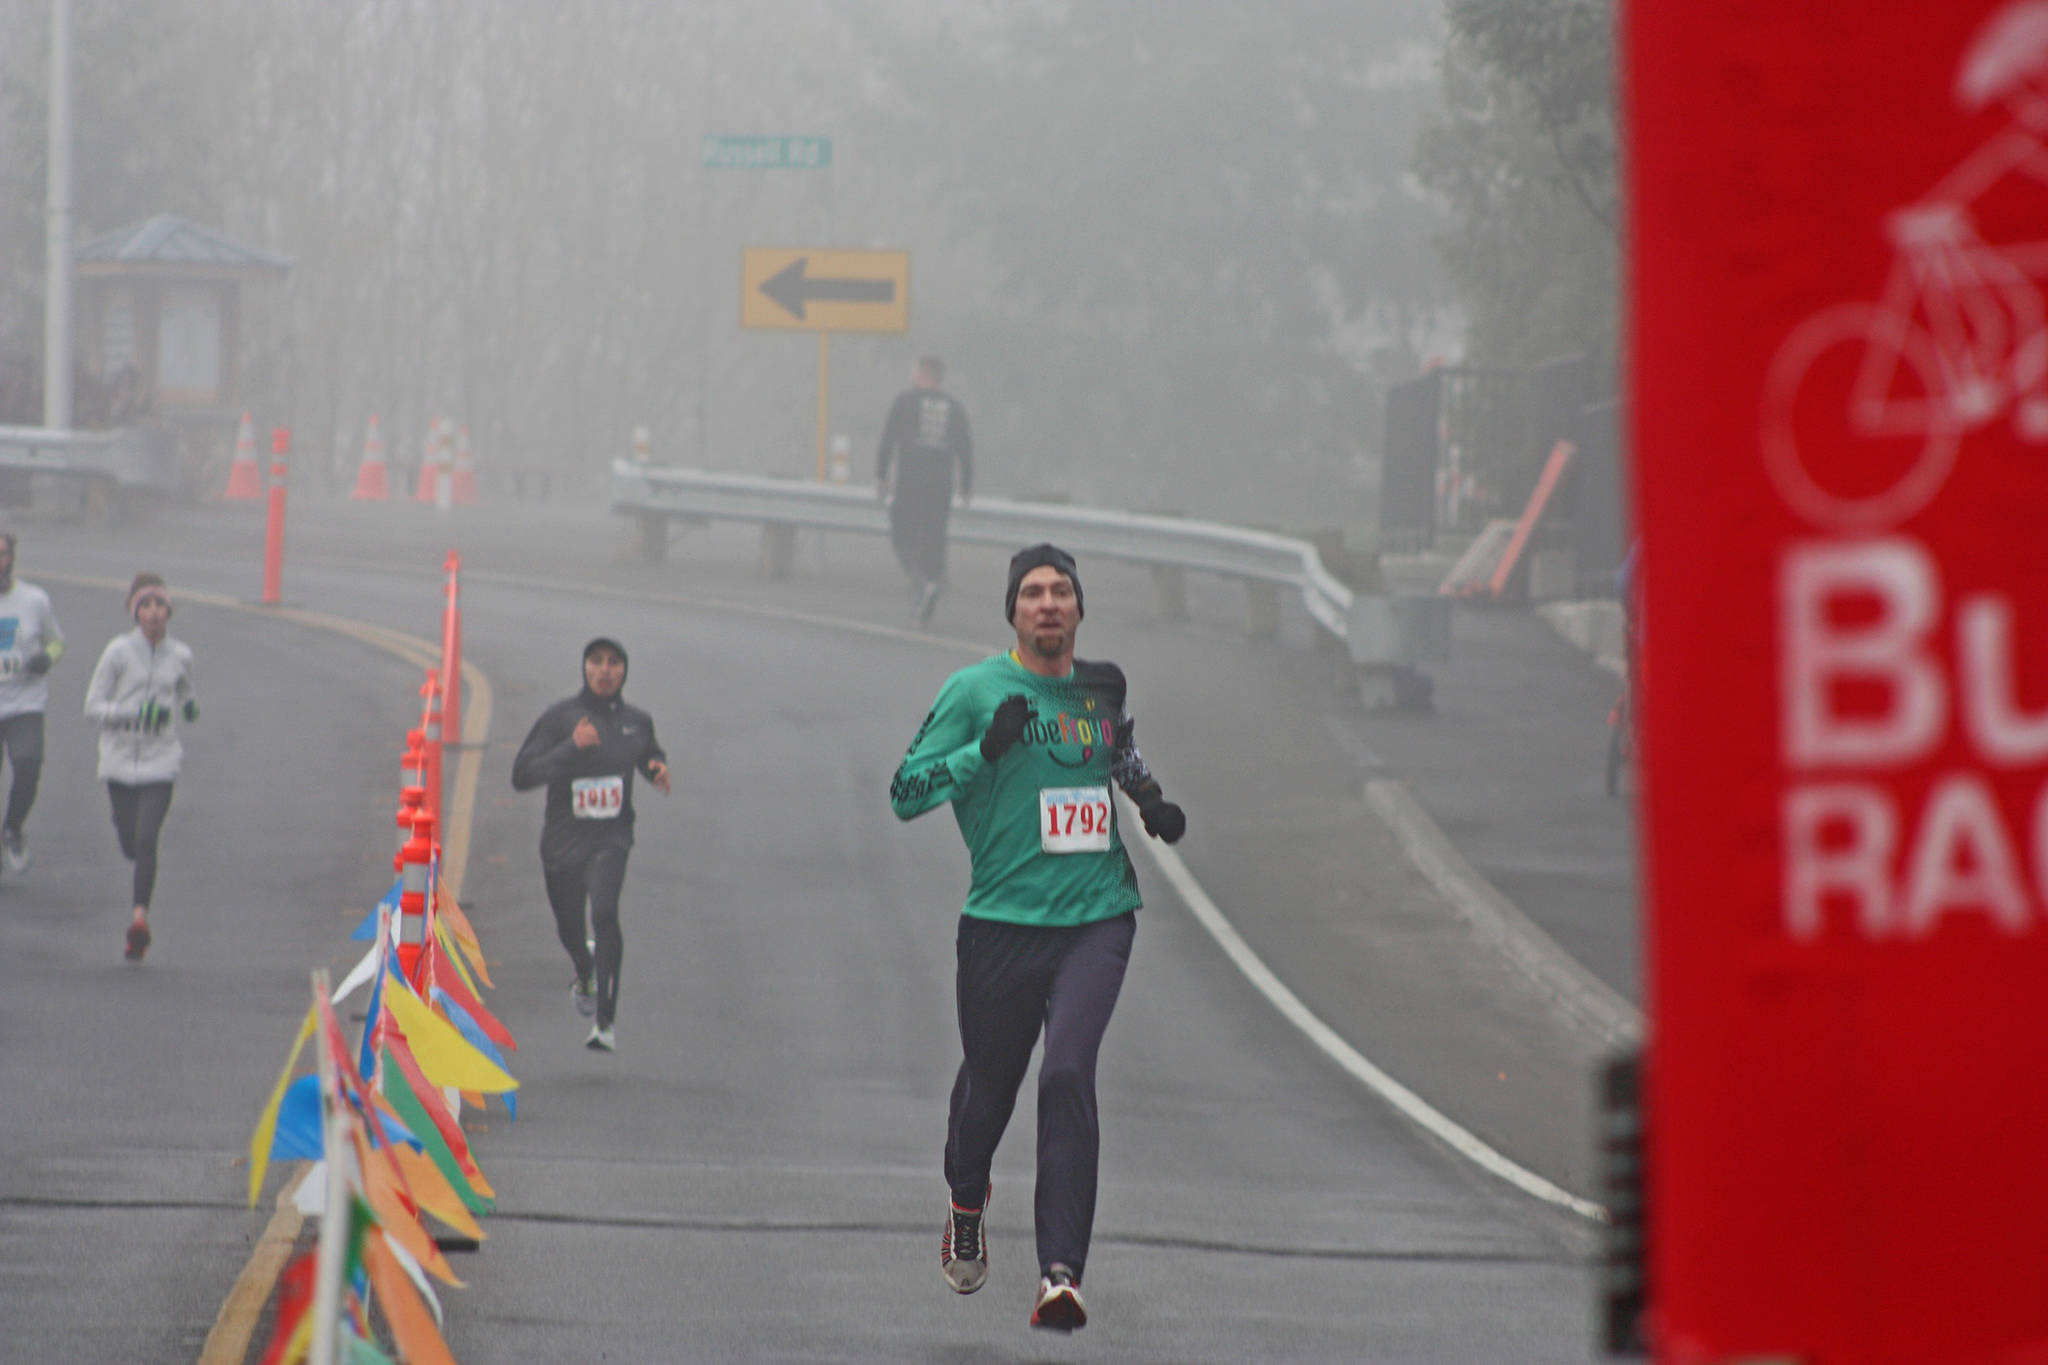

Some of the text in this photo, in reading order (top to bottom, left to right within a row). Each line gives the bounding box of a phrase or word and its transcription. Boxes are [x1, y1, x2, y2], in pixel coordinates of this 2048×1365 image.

[789, 138, 818, 165] Rd
[1047, 801, 1108, 837] 1792
[1781, 775, 2048, 940] RA
